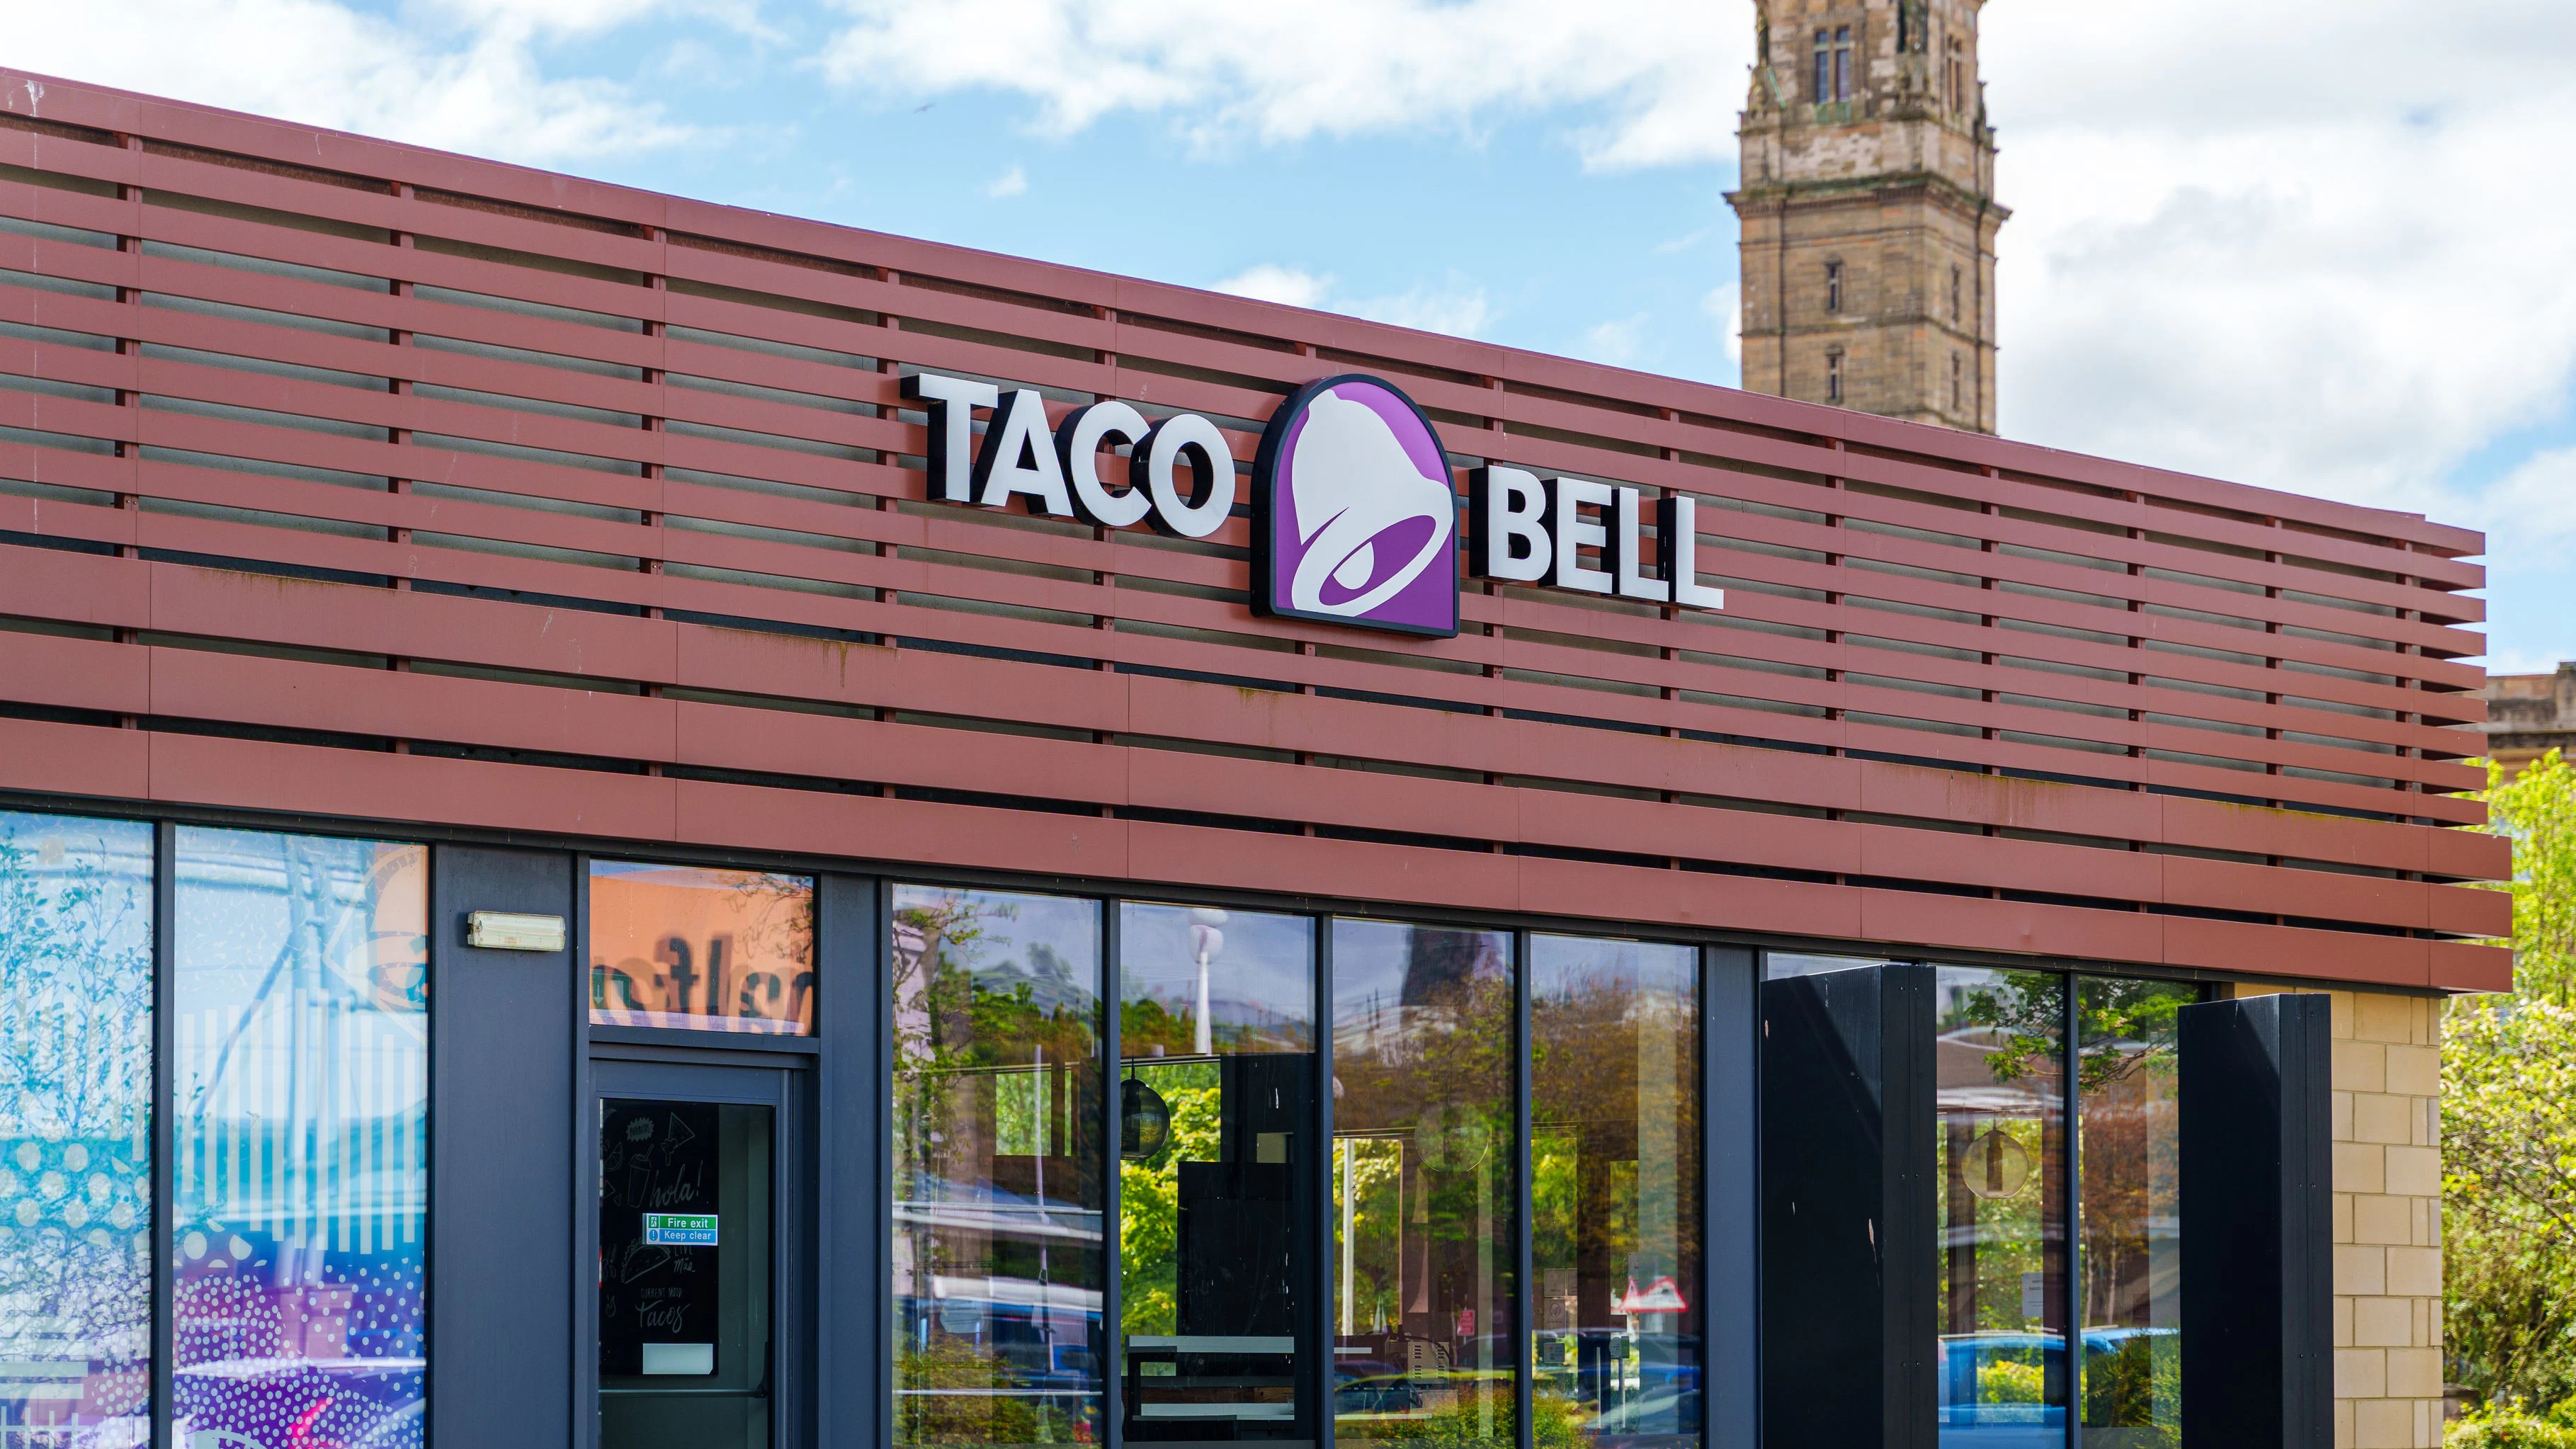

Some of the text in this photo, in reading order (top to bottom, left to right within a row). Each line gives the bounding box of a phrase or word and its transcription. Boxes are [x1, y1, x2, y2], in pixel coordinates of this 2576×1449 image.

[912, 371, 1725, 610] TACO BELL
[668, 1217, 708, 1228] Fire exit
[664, 1230, 711, 1241] Keep clear
[635, 1300, 692, 1334] Tacos
